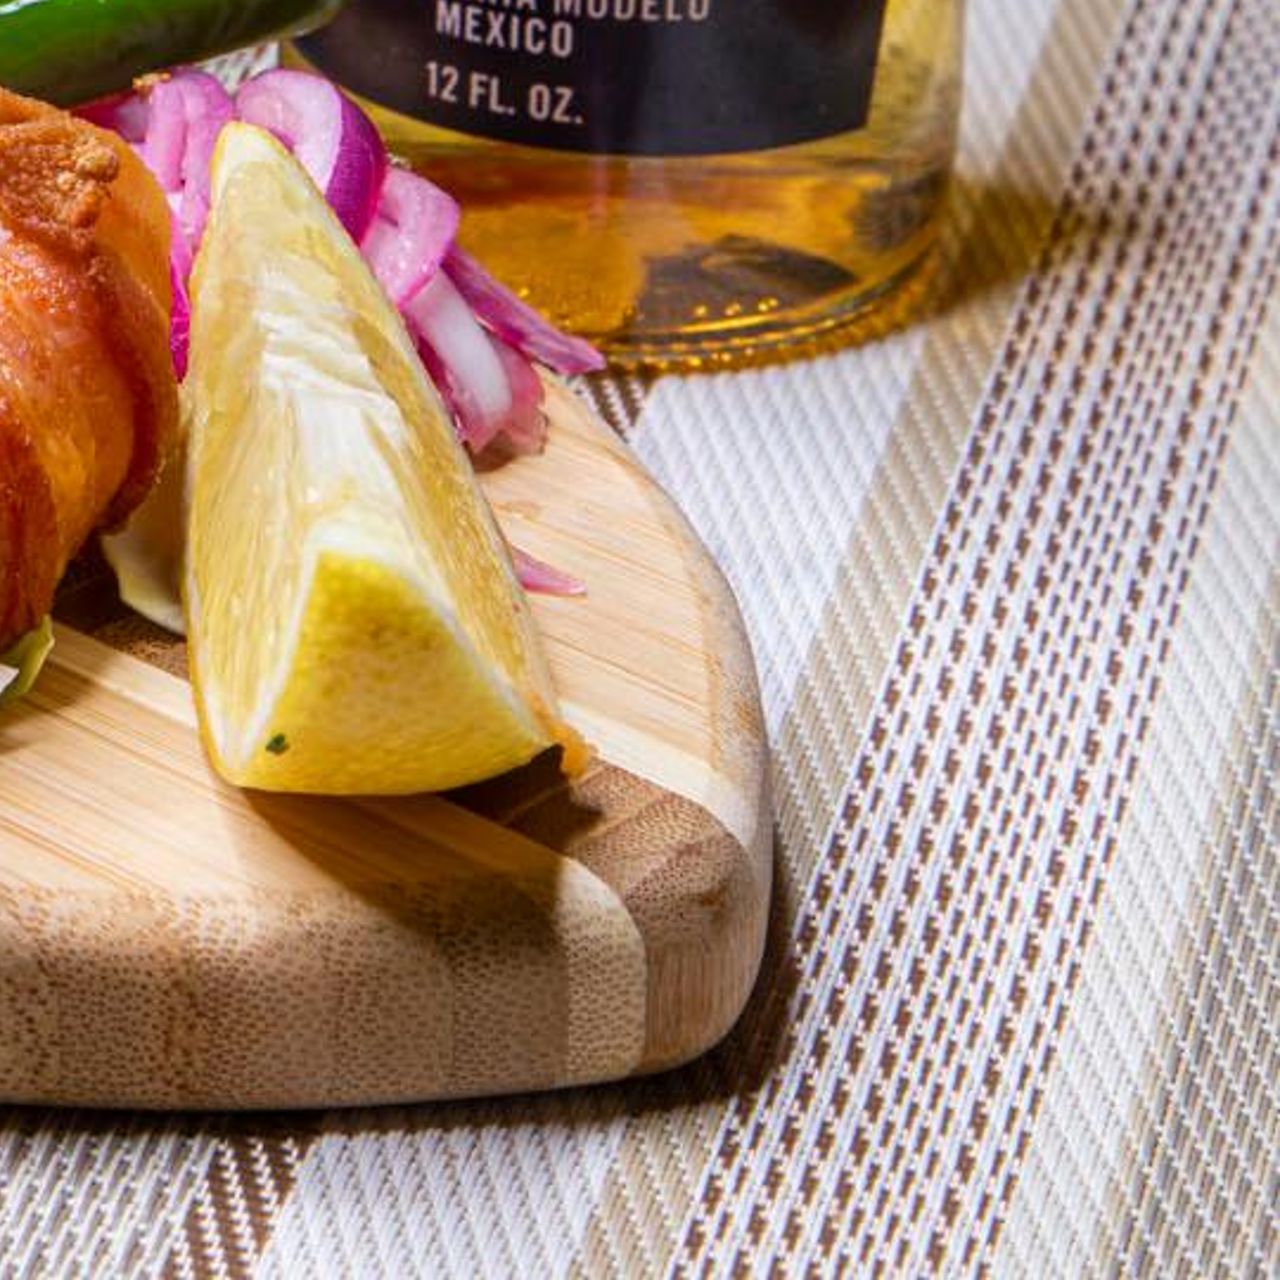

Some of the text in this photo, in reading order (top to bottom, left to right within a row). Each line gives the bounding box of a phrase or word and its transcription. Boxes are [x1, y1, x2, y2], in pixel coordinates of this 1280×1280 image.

[426, 60, 584, 125] 12 FL. OZ.
